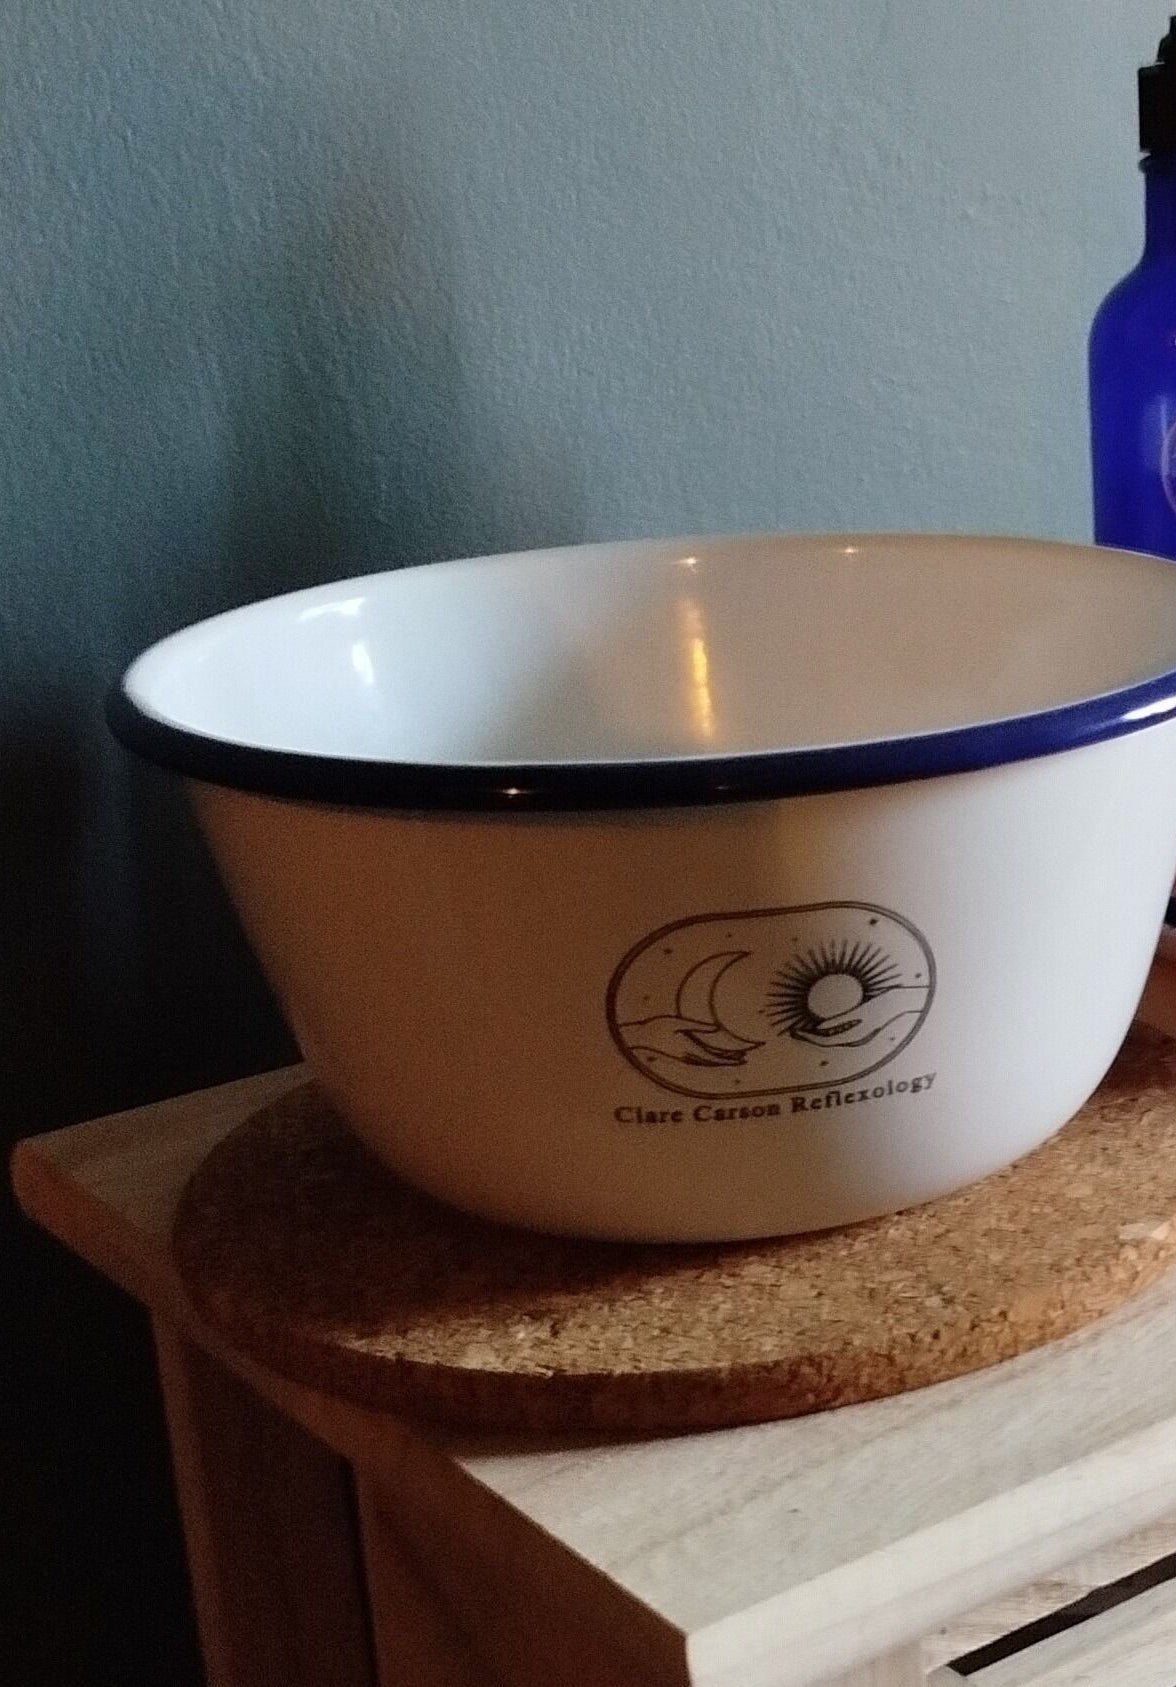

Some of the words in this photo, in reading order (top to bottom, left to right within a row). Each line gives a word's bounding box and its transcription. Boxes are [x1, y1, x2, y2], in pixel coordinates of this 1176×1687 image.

[613, 1105, 684, 1125] Clare
[692, 1102, 782, 1123] Carson
[790, 1071, 938, 1114] Reflexology
